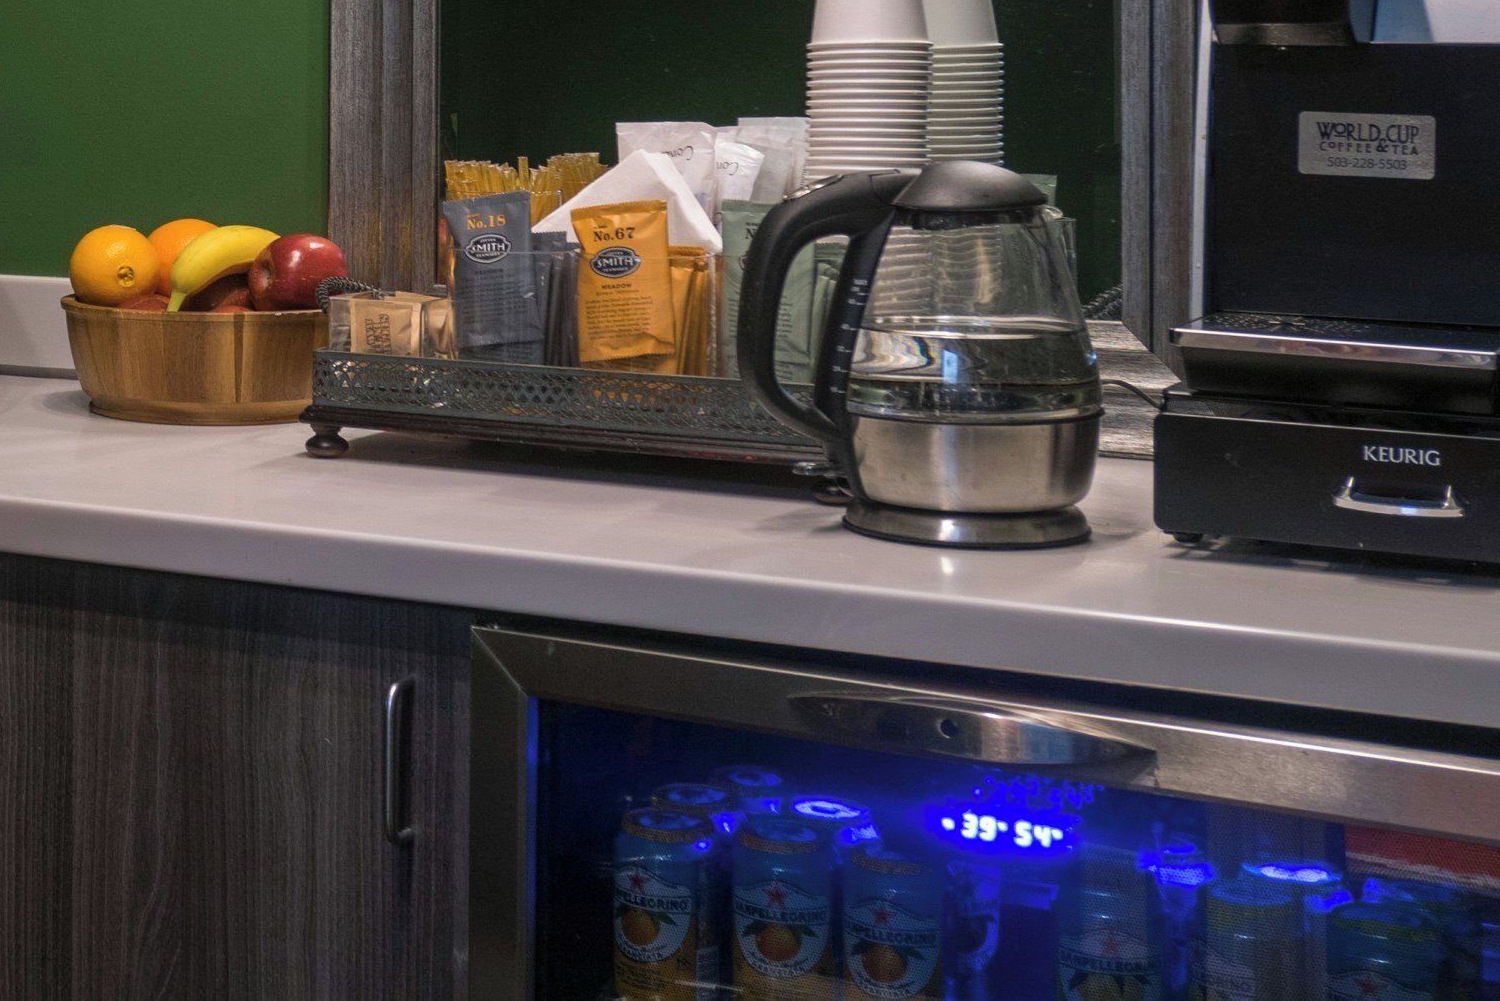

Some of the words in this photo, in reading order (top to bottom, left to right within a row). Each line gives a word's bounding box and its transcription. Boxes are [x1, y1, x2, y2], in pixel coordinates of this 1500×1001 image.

[1316, 122, 1381, 142] WORLD
[1386, 124, 1419, 144] CUP
[1376, 138, 1389, 152] &
[1390, 144, 1419, 155] TEA
[1327, 157, 1408, 170] 503-228-5503
[593, 227, 636, 242] No.67
[471, 243, 506, 254] SMITH
[598, 257, 634, 268] SMITH
[1363, 445, 1441, 466] KEURIG
